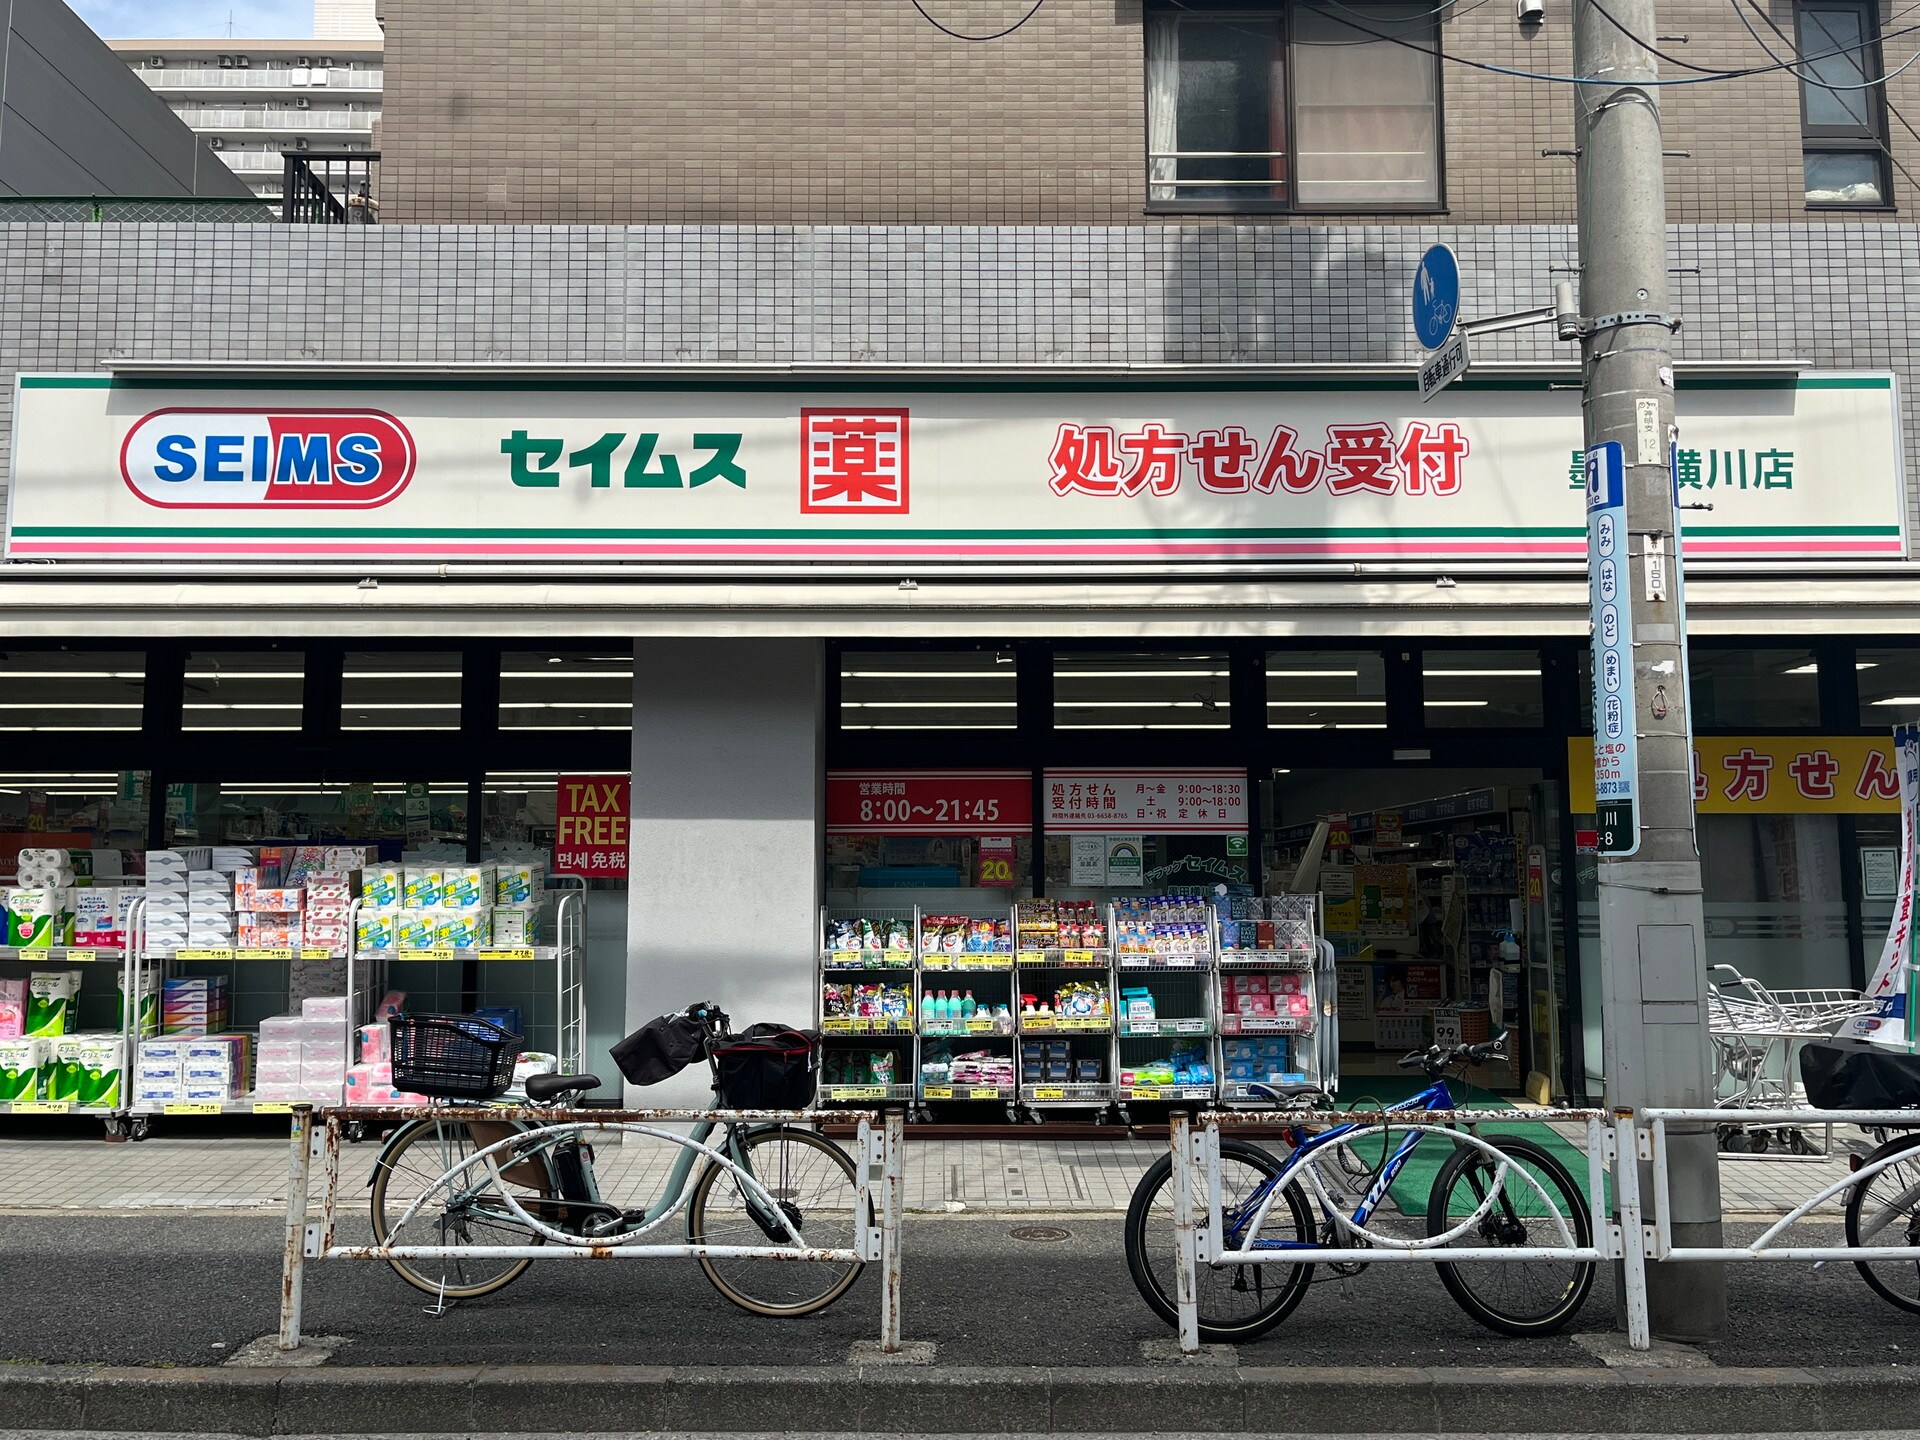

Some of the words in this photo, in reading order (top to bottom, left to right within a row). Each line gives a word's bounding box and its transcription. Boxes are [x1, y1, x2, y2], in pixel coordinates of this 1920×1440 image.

[1422, 341, 1464, 393] 自転車通行可
[1644, 438, 1656, 450] 12
[154, 433, 383, 486] SEIMS
[500, 430, 747, 489] セイムス
[811, 417, 897, 503] 薬
[1048, 421, 1470, 497] 処方せん受付
[1599, 523, 1612, 547] みみ
[1602, 570, 1613, 592] はな
[1603, 613, 1615, 637] のど
[1605, 655, 1618, 686] めまい
[1607, 699, 1619, 733] 花粉症
[565, 783, 621, 813] TAX
[859, 782, 906, 796] 営業時間
[1051, 783, 1116, 796] 処方せん
[1146, 796, 1156, 806] 土
[1051, 796, 1116, 810] 受付時間
[558, 816, 627, 845] FREE
[557, 851, 588, 869] 면세
[591, 851, 626, 869] 免税
[1436, 1027, 1455, 1038] 99
